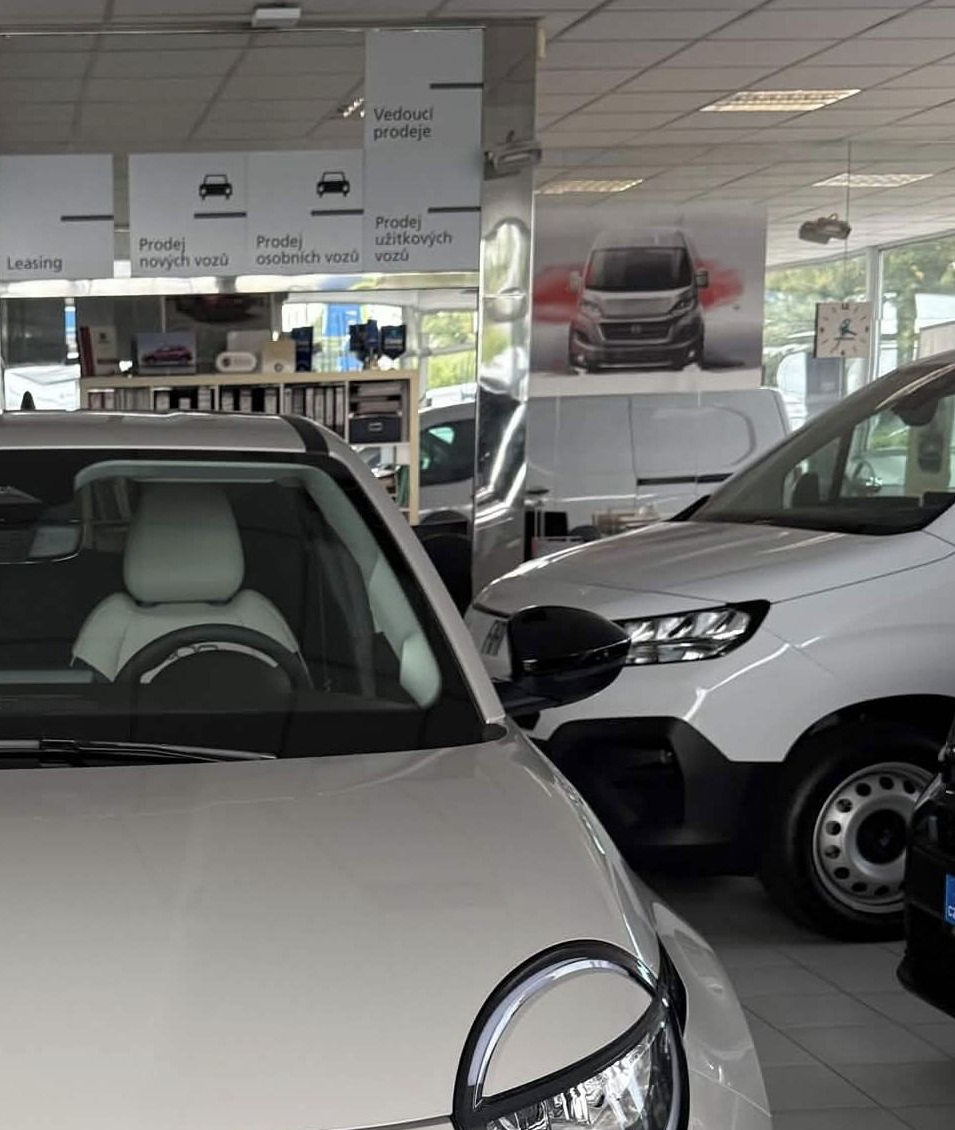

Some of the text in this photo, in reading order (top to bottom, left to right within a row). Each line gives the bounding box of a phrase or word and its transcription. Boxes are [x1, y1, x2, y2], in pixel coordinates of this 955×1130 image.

[373, 106, 434, 121] Vedoucí
[373, 124, 431, 140] prodeje
[375, 214, 422, 232] Prodej
[139, 236, 186, 254] Prodej
[256, 234, 303, 251] Prodej
[375, 231, 453, 248] užitkových
[139, 252, 230, 271] nových vozů
[256, 248, 359, 265] osobních vozů
[375, 248, 410, 262] vozů
[7, 256, 63, 272] Leasing
